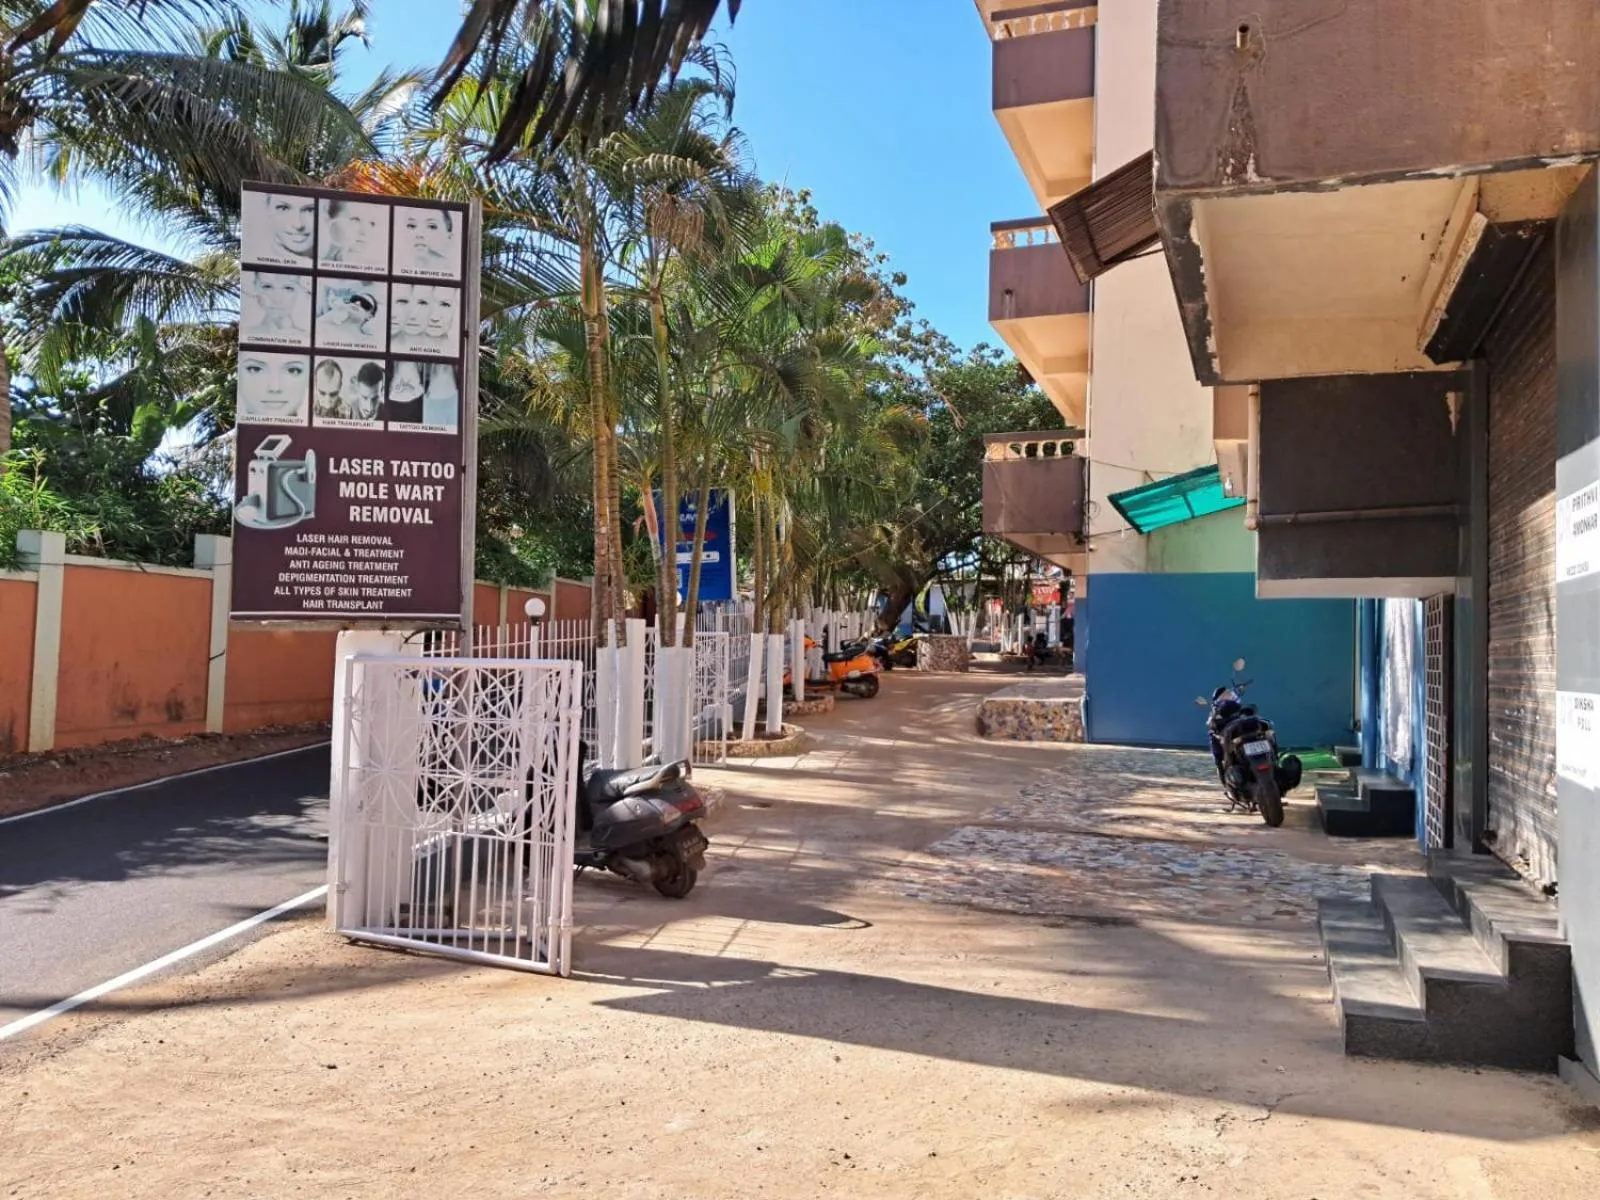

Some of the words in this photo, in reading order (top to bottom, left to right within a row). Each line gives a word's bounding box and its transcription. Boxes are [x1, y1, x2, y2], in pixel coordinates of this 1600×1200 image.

[329, 458, 384, 476] LASER
[390, 460, 455, 479] TATTOO
[339, 484, 389, 500] MOLE
[395, 485, 444, 502] WART
[349, 506, 433, 524] REMOVAL
[297, 534, 325, 543] LASER
[328, 535, 349, 544] HAIR
[351, 535, 393, 545] REMOVAL
[344, 549, 350, 557] &
[354, 549, 404, 558] TREATMENT
[290, 560, 310, 569] ANTI
[312, 561, 345, 570] AGEING
[348, 562, 399, 571] TREATMENT
[278, 573, 355, 583] DEPIGMENTATION
[358, 574, 408, 584] TREATMENT
[274, 586, 290, 595] ALL
[293, 586, 321, 596] TYPES
[324, 587, 336, 596] OF
[337, 587, 358, 596] SKIN
[361, 588, 412, 597] TREATMENT
[303, 599, 325, 608] HAIR
[327, 600, 384, 610] TRANSPLANT
